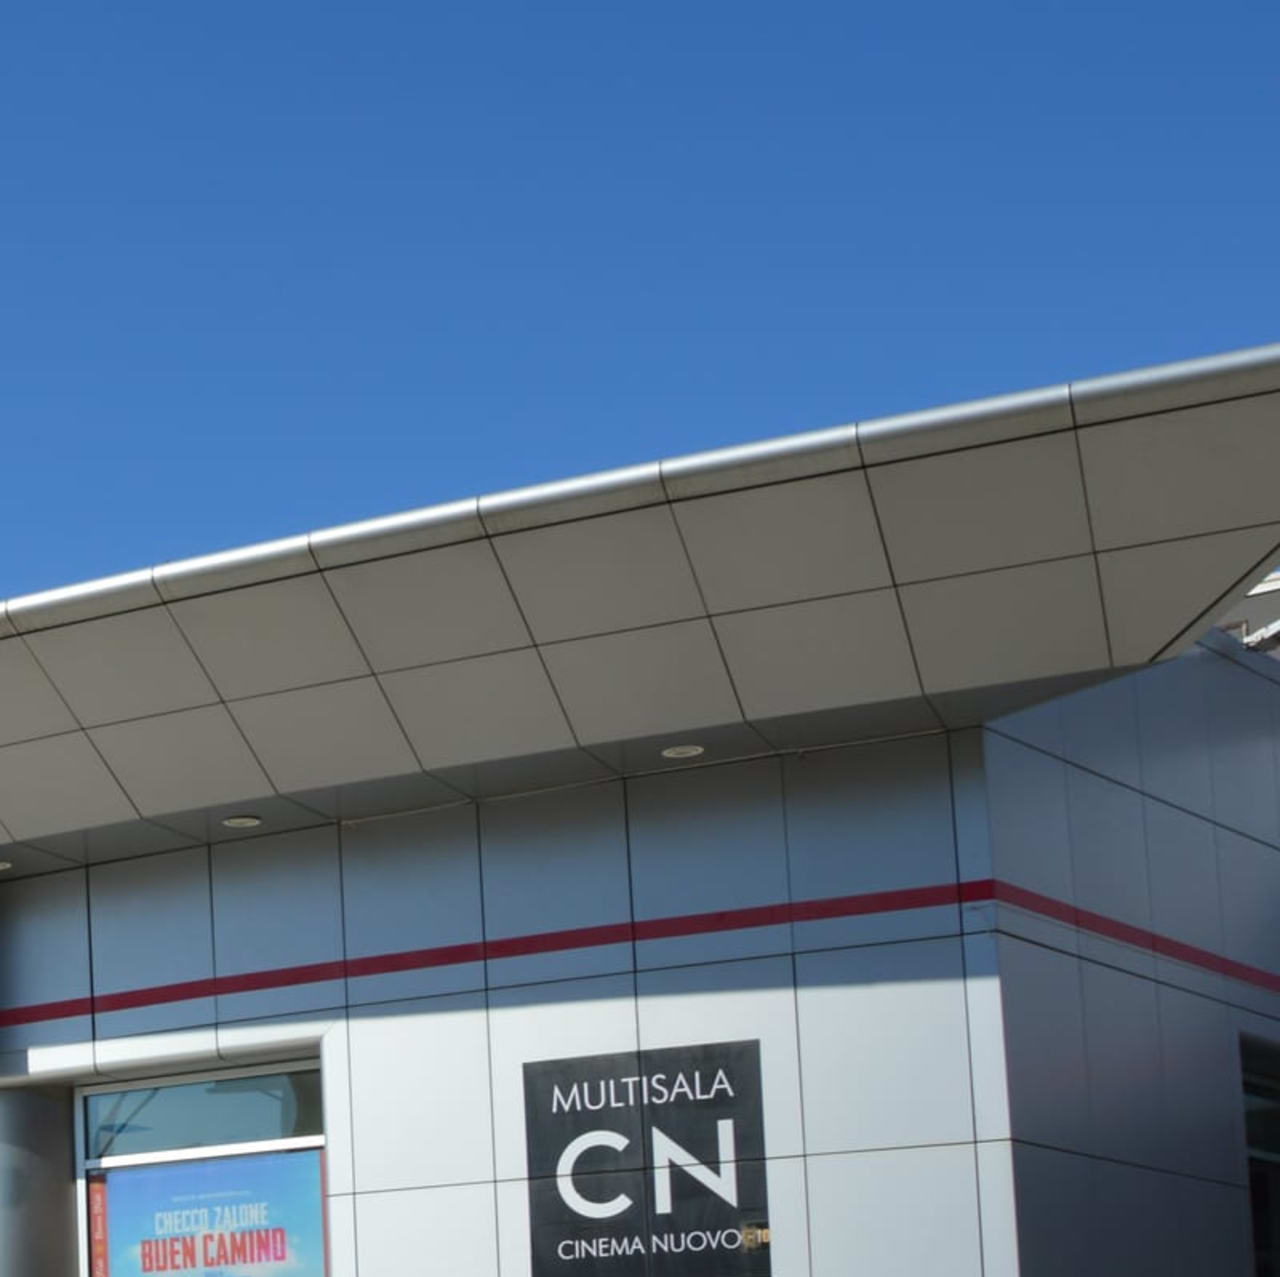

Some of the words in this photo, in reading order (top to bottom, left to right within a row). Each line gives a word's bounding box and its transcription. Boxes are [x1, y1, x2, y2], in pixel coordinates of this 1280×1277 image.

[551, 1068, 734, 1114] MULTISALA
[556, 1118, 738, 1219] CN
[154, 1208, 209, 1236] CHECCO
[214, 1202, 269, 1228] ZALONE
[140, 1235, 197, 1273] BUEN
[202, 1227, 287, 1268] CAMINO
[557, 1236, 645, 1261] CINEMA
[652, 1228, 741, 1254] NUOVO
